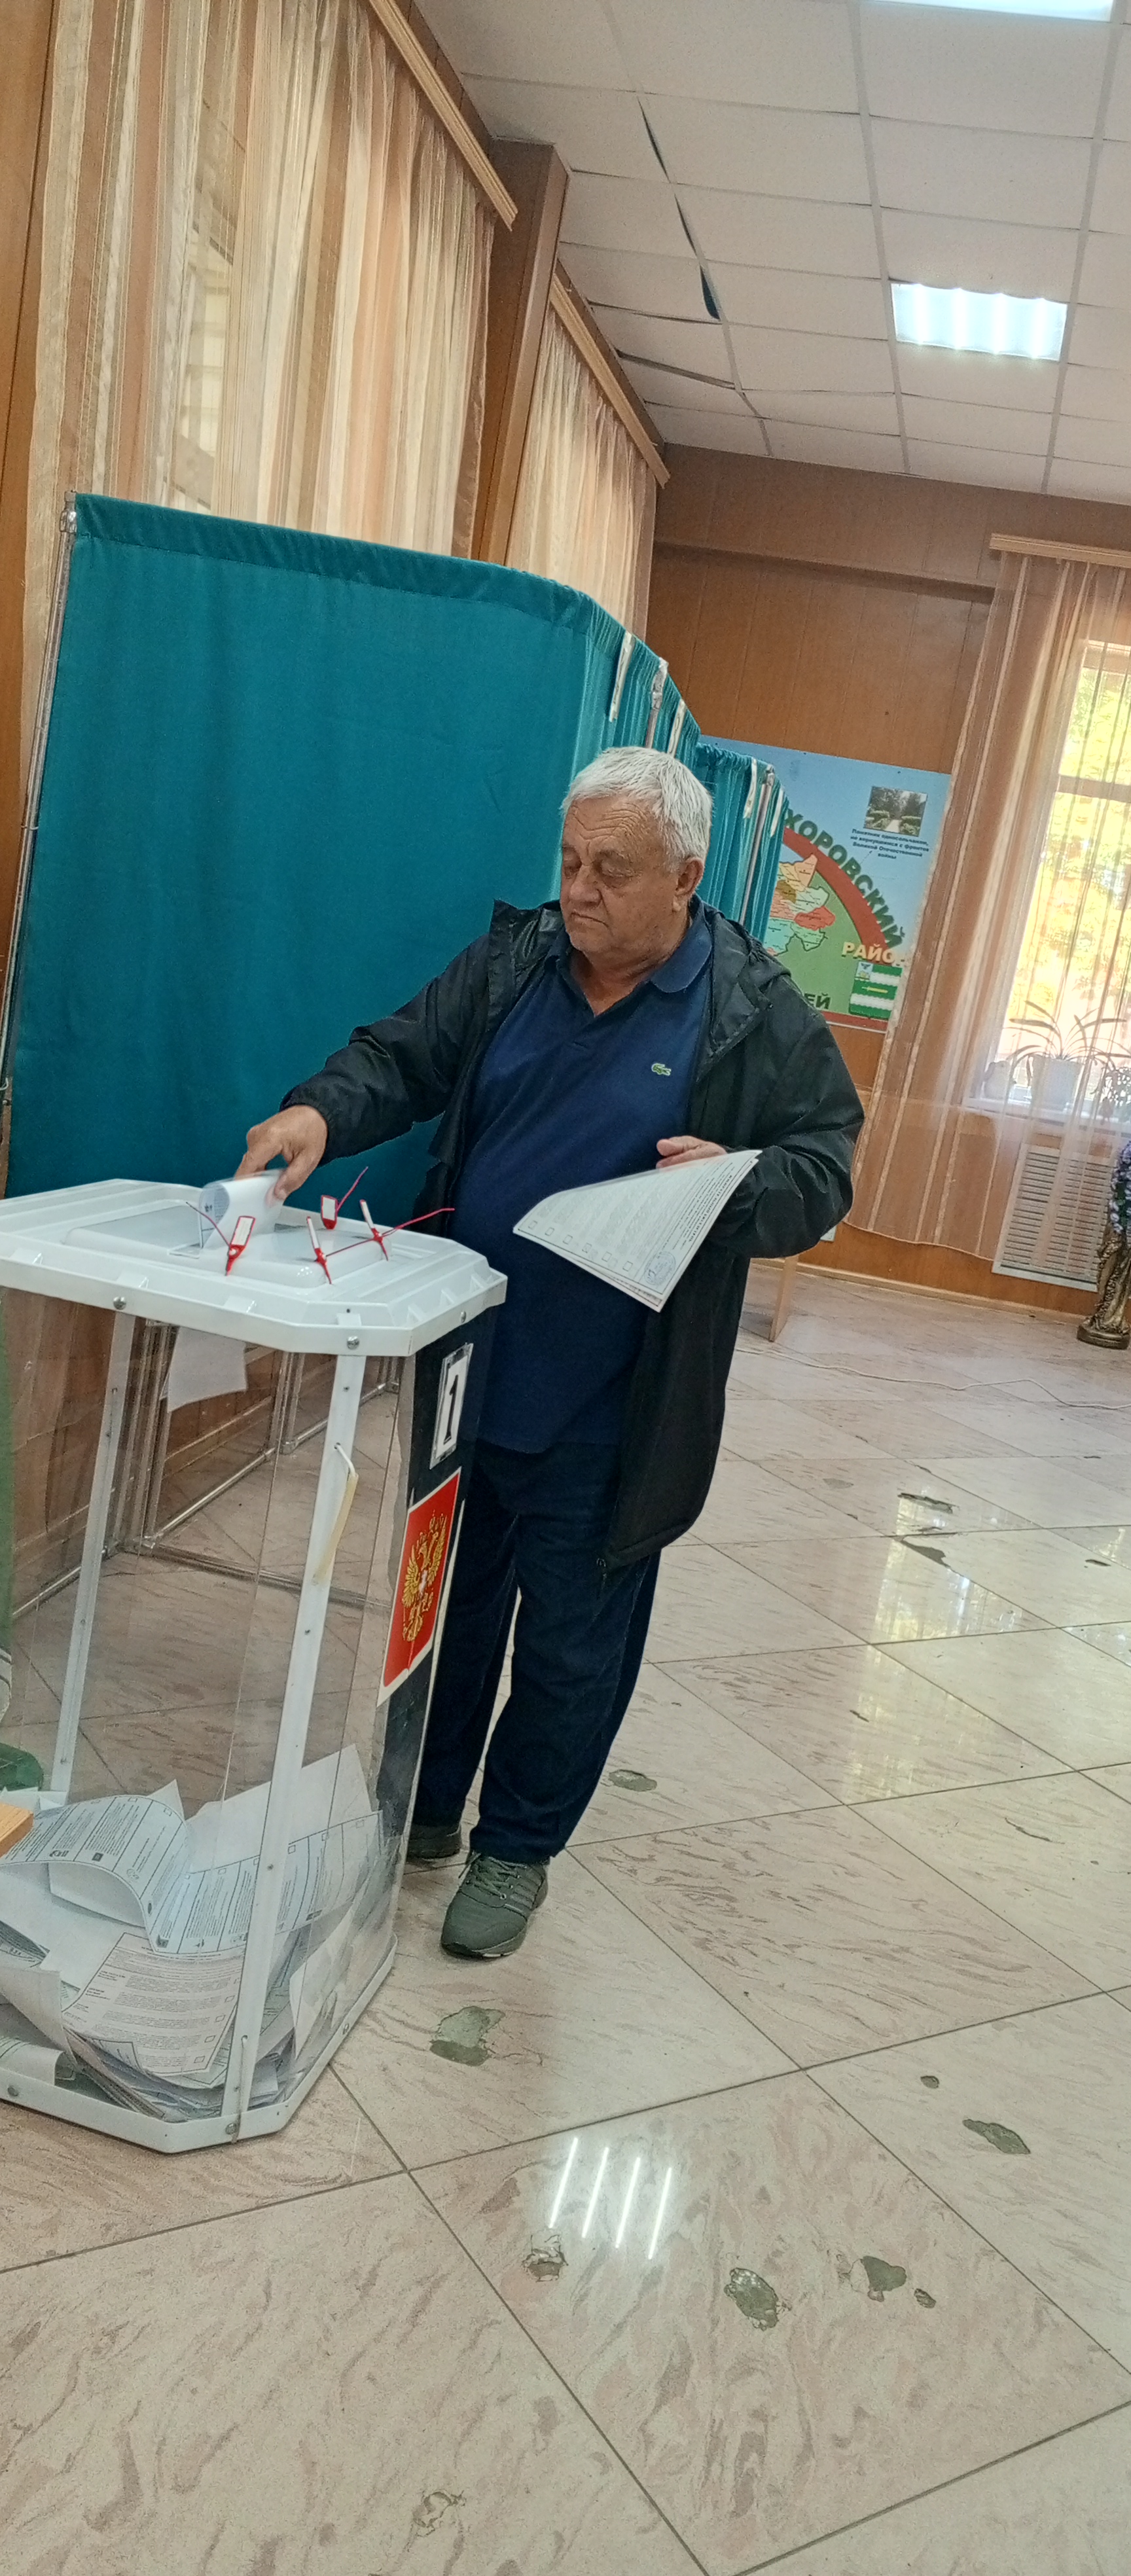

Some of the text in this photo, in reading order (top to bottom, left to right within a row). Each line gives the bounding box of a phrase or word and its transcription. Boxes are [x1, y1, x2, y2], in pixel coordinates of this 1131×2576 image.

[785, 808, 905, 948] ХОРОВСКИЙ
[841, 941, 905, 965] РАЙО
[804, 992, 831, 1010] ЕЙ
[443, 1374, 459, 1445] 1
